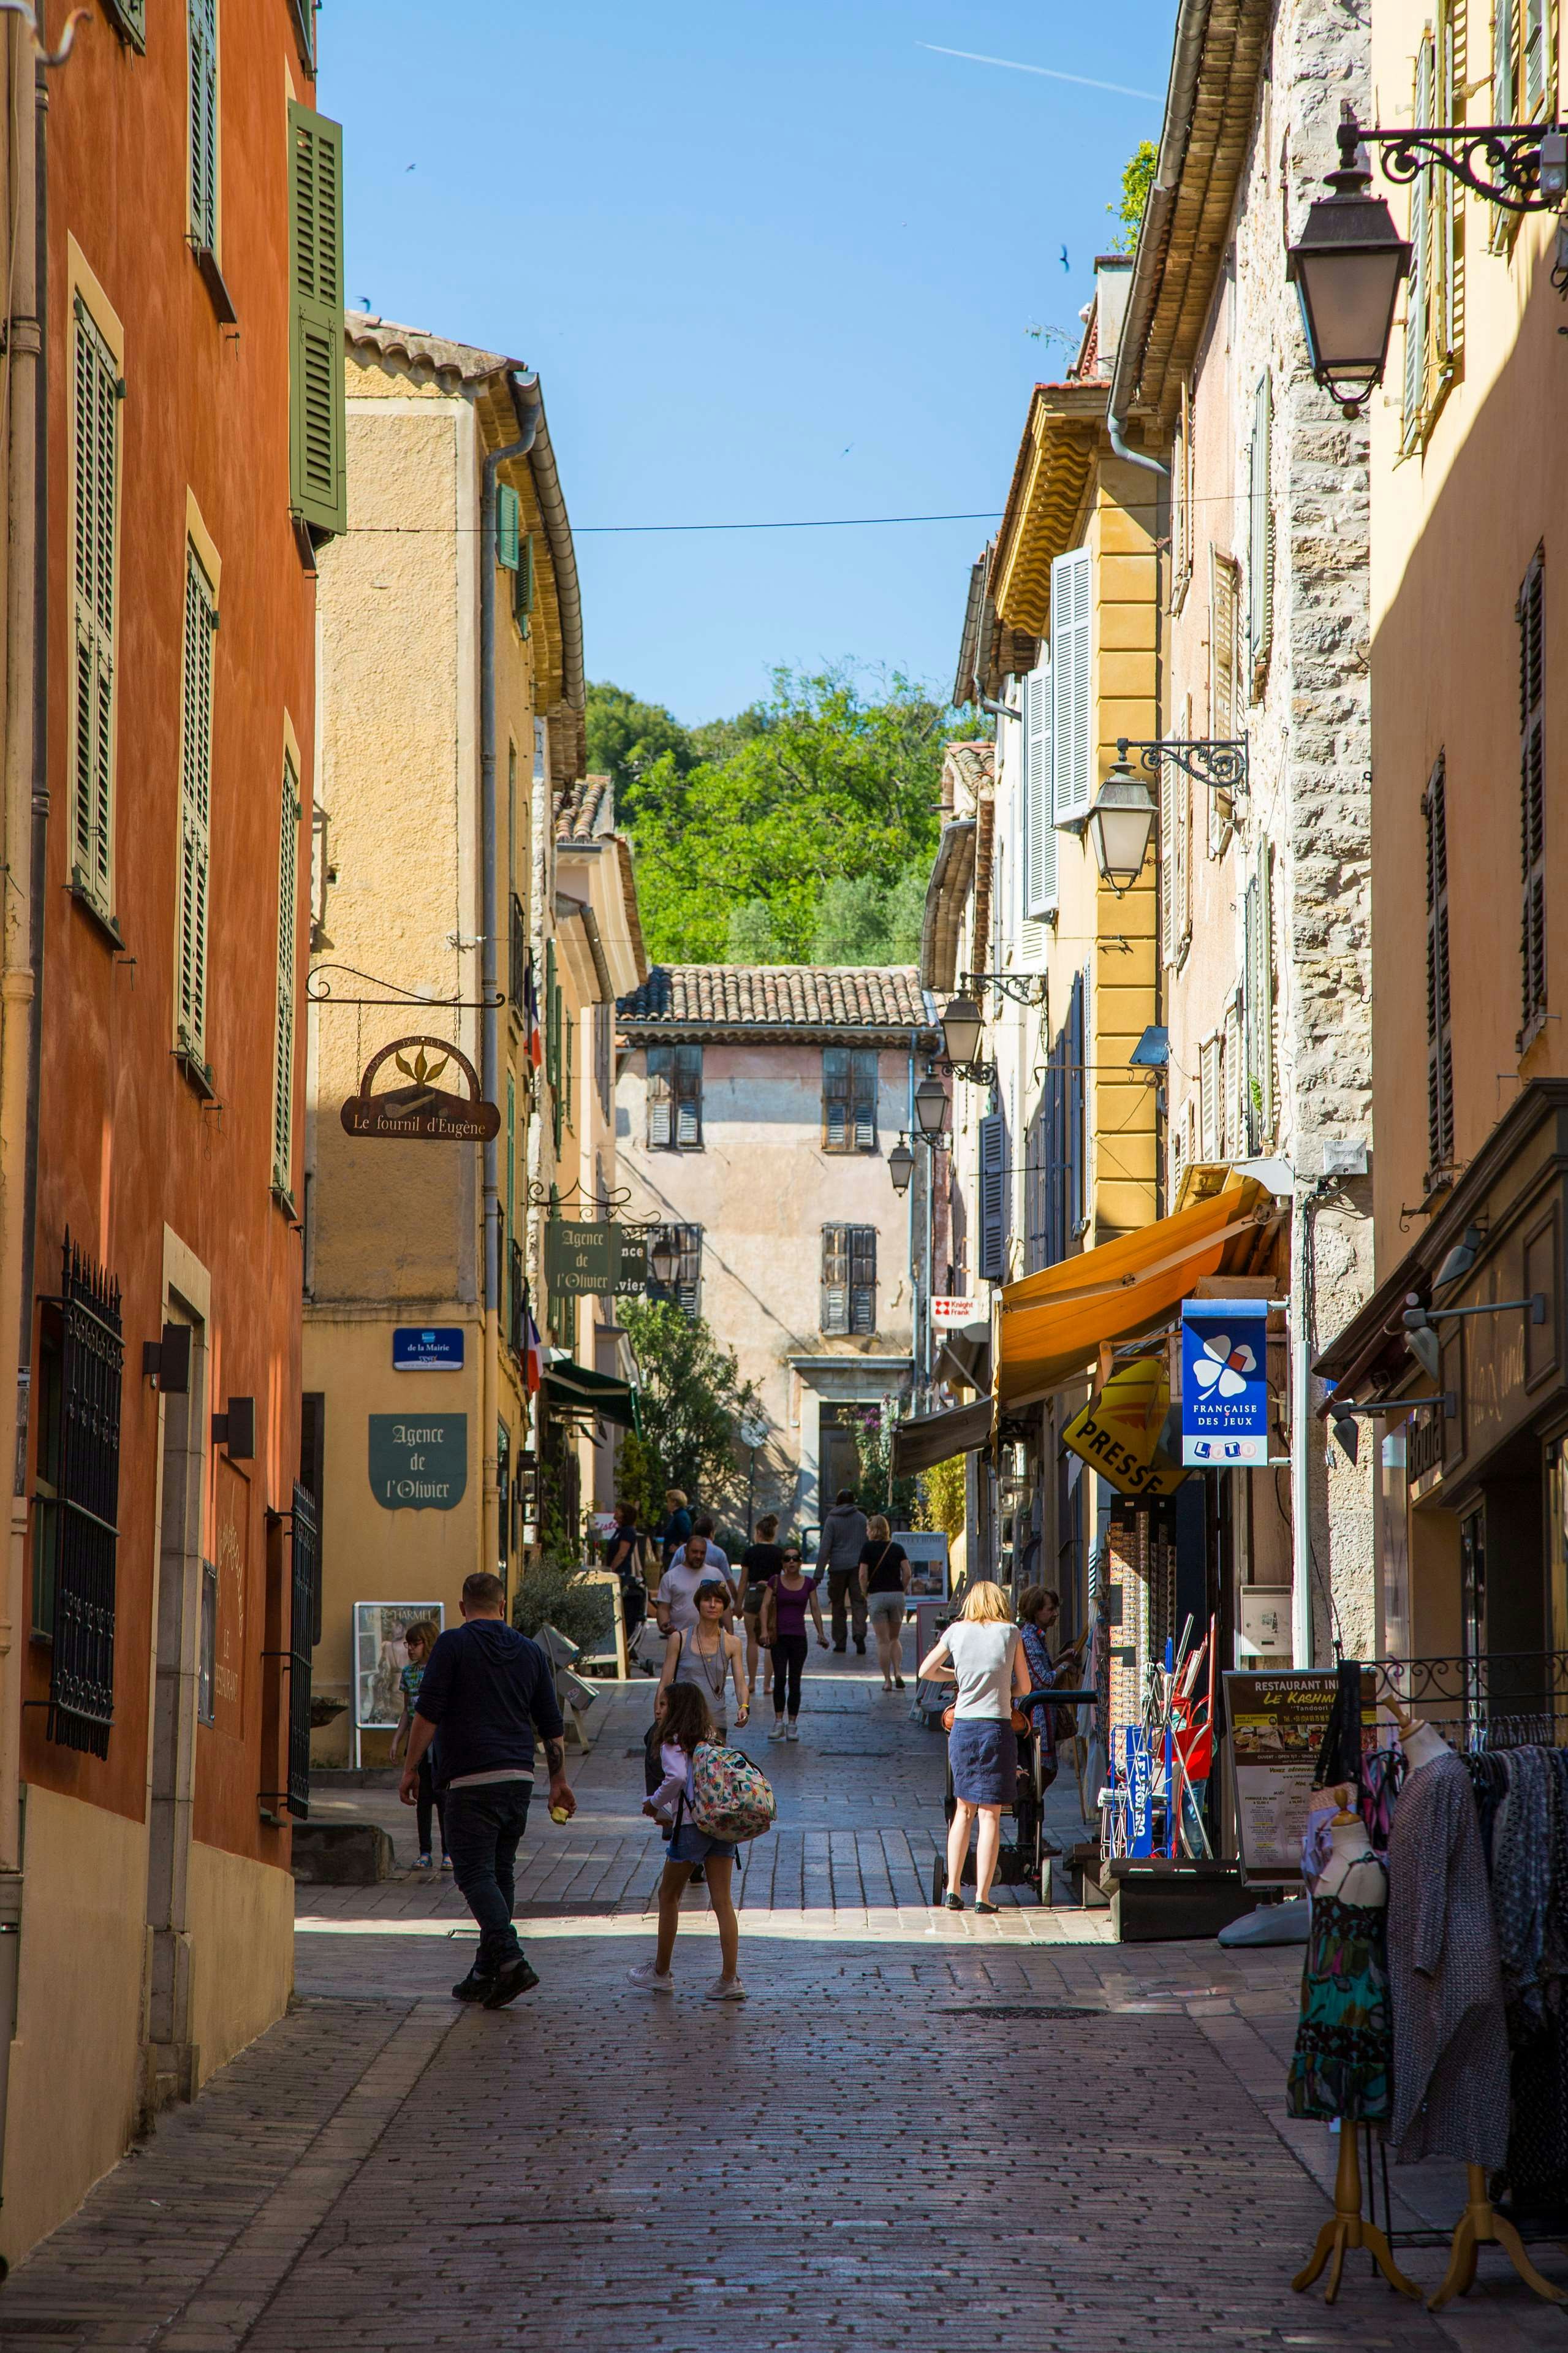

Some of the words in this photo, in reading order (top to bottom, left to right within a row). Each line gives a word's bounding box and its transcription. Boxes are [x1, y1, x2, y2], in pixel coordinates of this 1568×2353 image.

[354, 1114, 369, 1129] Le
[377, 1115, 420, 1132] fournil
[427, 1117, 485, 1139] d'Eugène
[561, 1230, 604, 1248] Agence
[621, 1247, 644, 1257] nce
[575, 1253, 589, 1268] de
[556, 1272, 608, 1289] l'Olivier
[951, 1301, 974, 1309] Knight
[1193, 1405, 1257, 1415] FRANÇAISE
[1224, 1418, 1252, 1427] JEUX
[392, 1425, 444, 1447] Agence
[1194, 1441, 1257, 1461] LOTO
[410, 1453, 426, 1471] de
[387, 1480, 450, 1499] l'Olivier
[1255, 1680, 1321, 1691] RESTAURANT
[1263, 1692, 1282, 1705] LE
